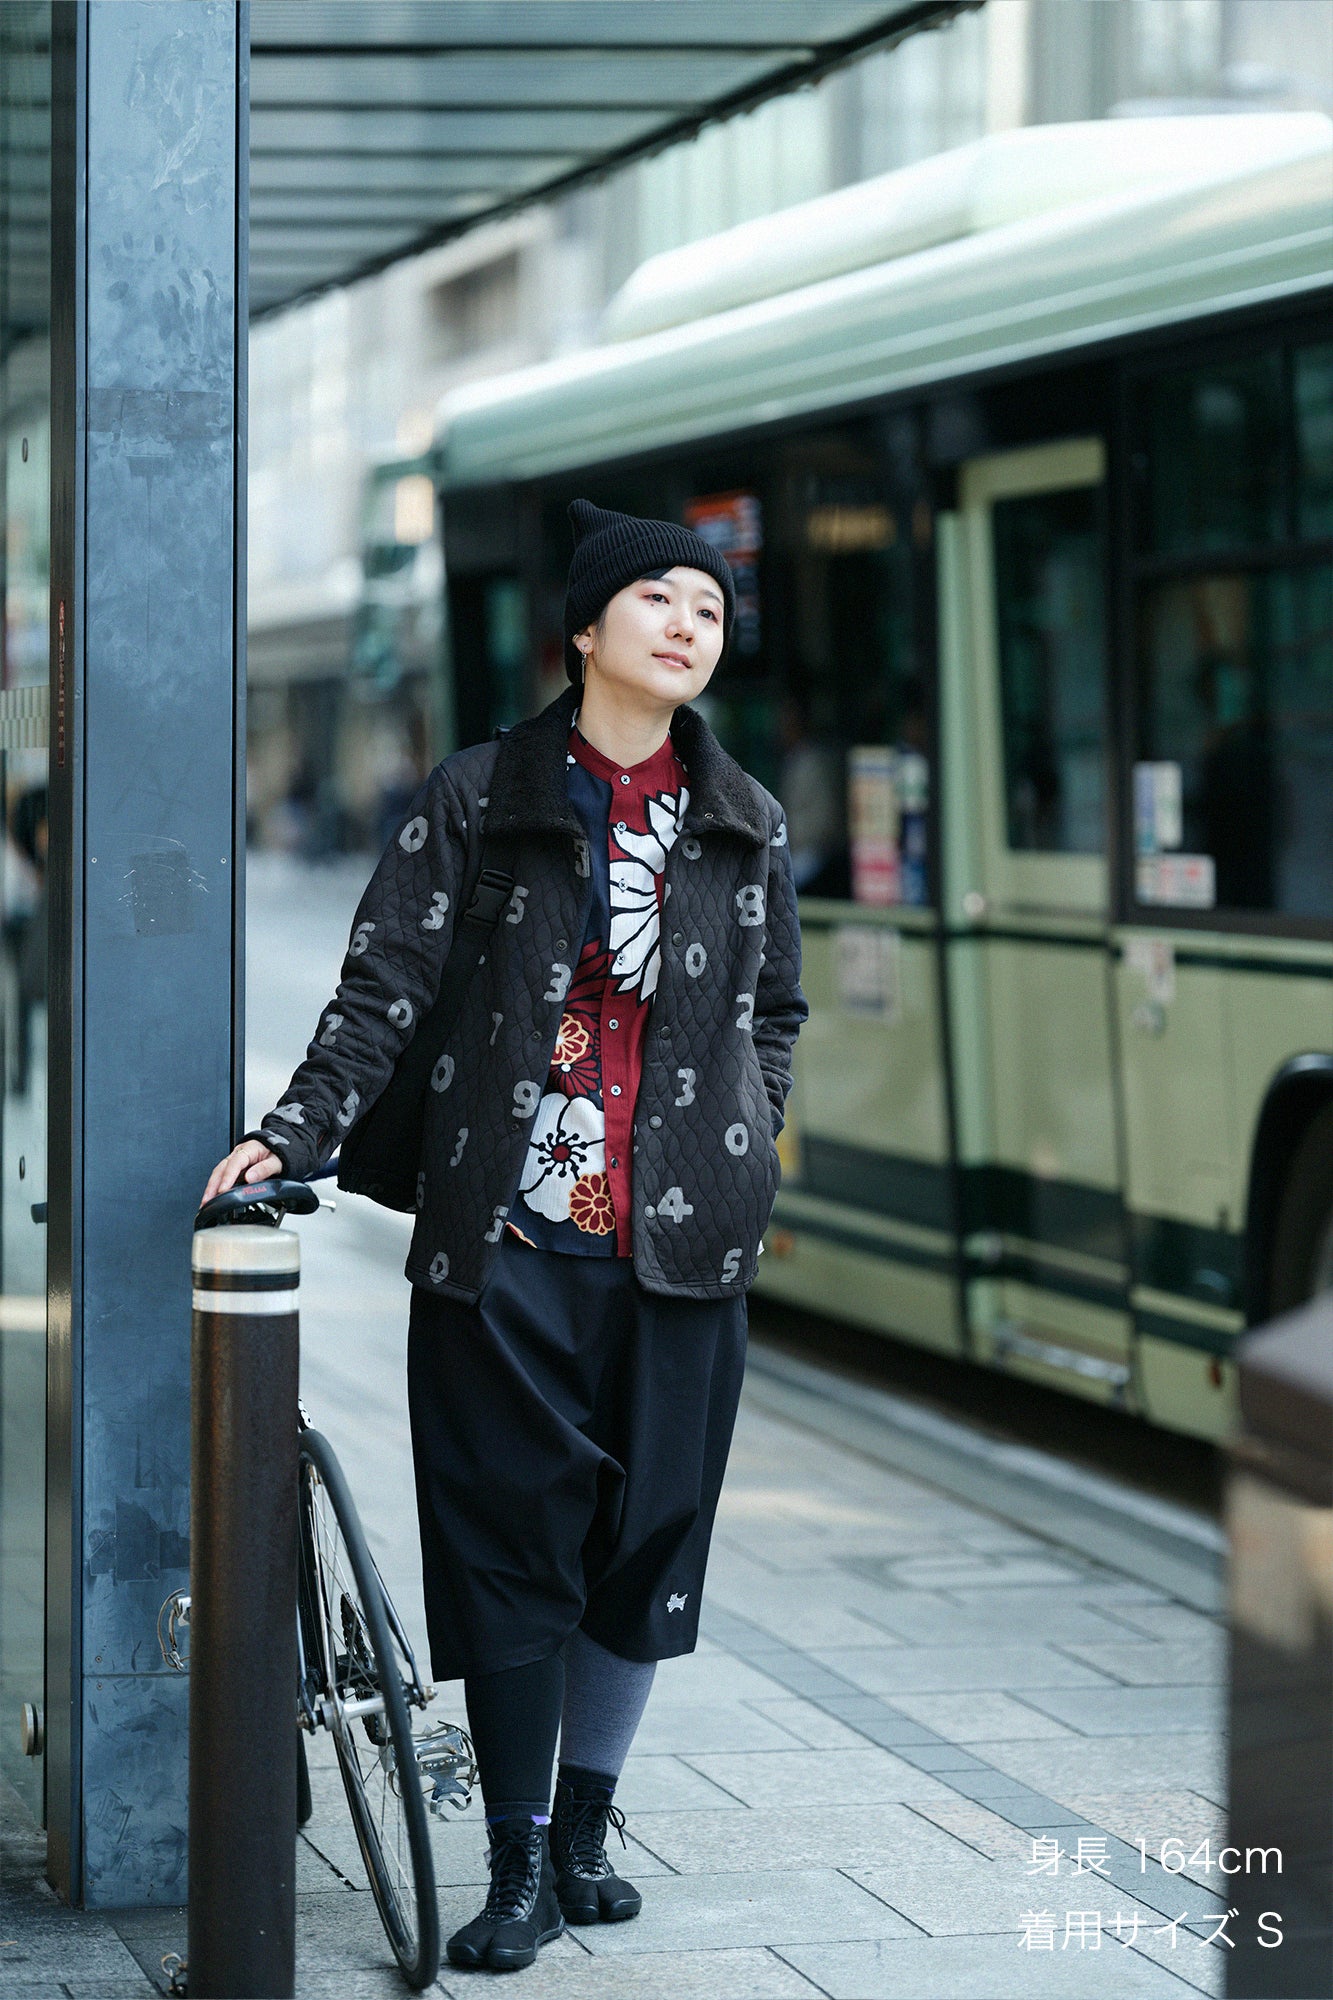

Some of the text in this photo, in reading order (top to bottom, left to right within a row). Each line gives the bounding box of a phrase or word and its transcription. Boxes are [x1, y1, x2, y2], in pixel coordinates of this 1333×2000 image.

[399, 816, 429, 853] 0
[421, 891, 449, 931] 3
[506, 886, 529, 924] 5
[350, 922, 376, 957] 6
[685, 943, 707, 978] 0
[544, 963, 571, 1002] 3
[320, 1013, 344, 1046] 2
[387, 999, 413, 1029] 0
[736, 993, 754, 1031] 2
[431, 1054, 455, 1093] 0
[675, 1068, 696, 1107] 3
[512, 1080, 541, 1118] 9
[725, 1122, 749, 1156] 0
[657, 1187, 694, 1223] 4
[429, 1252, 450, 1284] 0
[721, 1248, 742, 1283] 5
